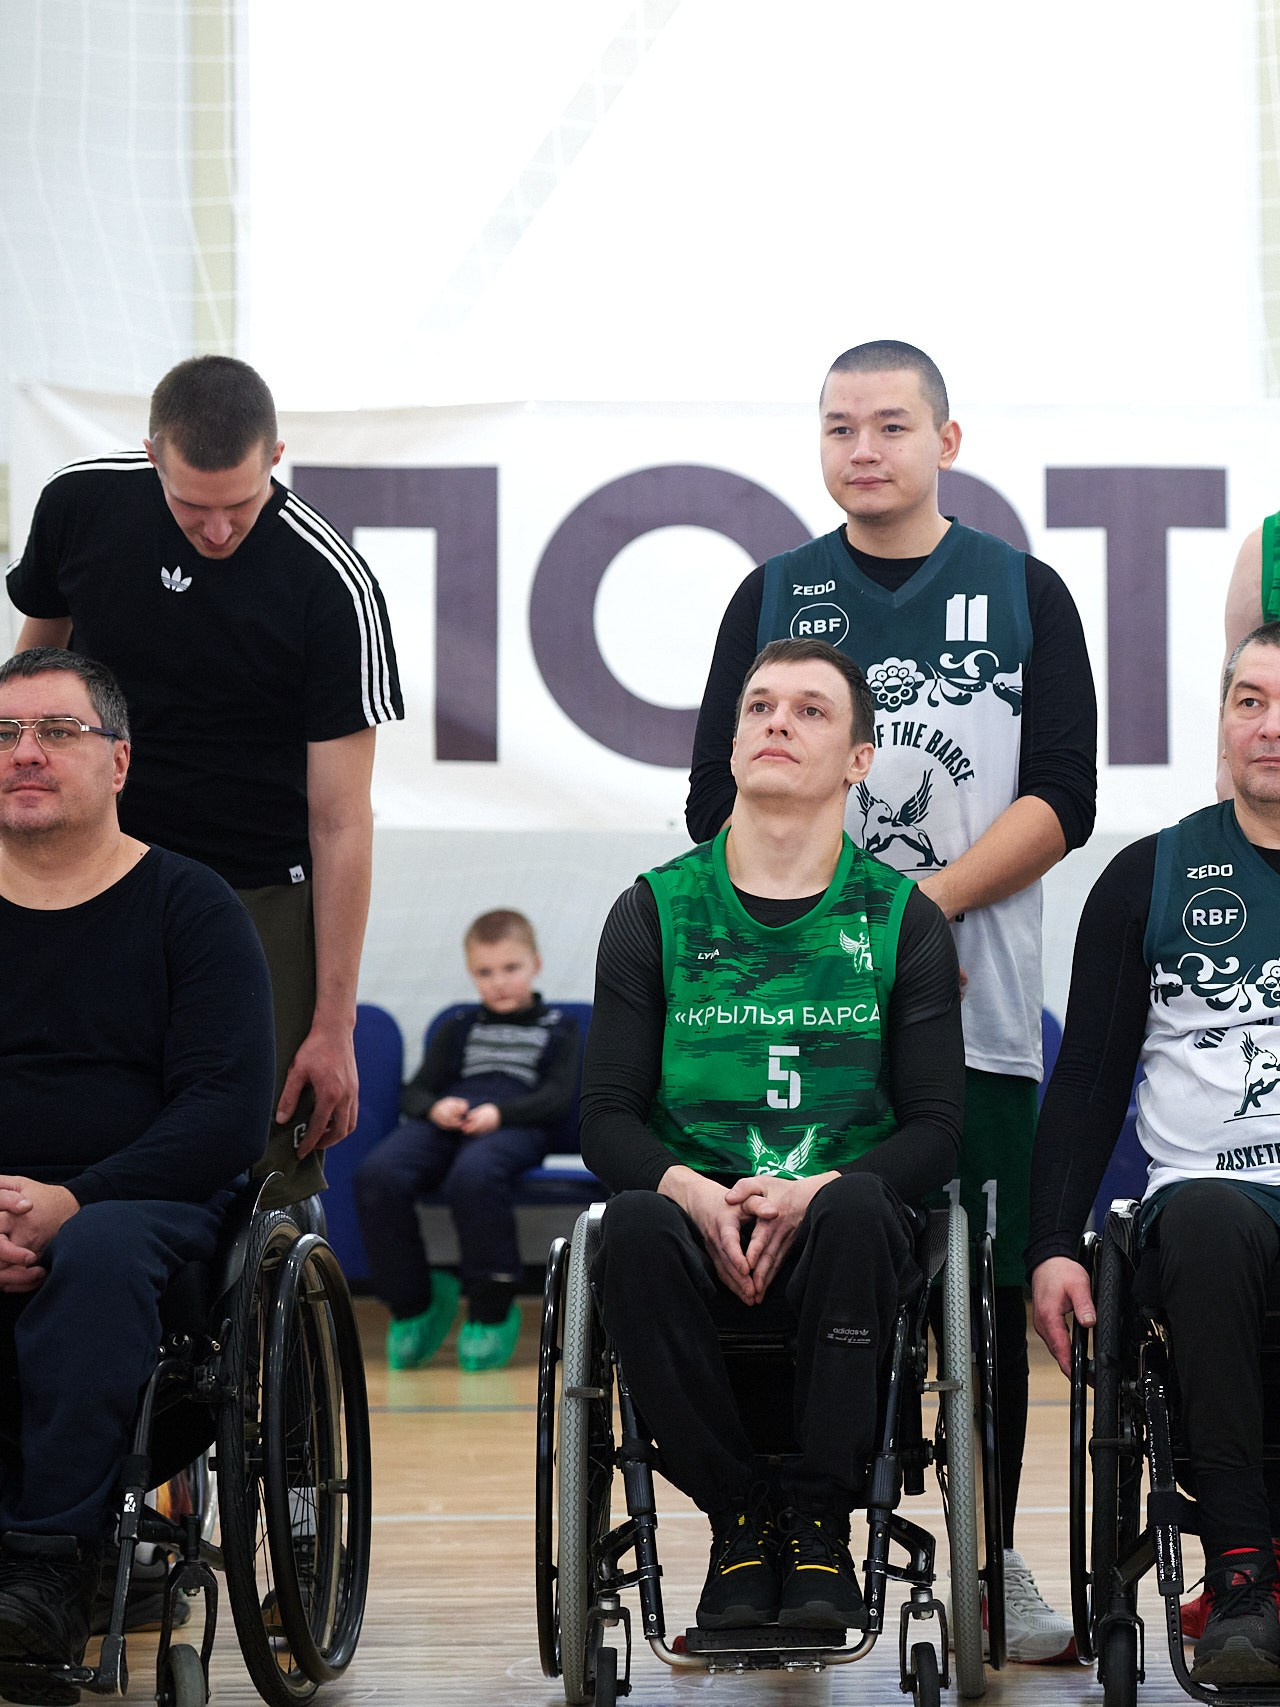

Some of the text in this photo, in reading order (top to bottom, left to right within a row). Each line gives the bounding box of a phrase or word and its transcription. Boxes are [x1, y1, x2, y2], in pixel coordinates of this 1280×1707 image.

[793, 580, 836, 596] ZEDO
[292, 463, 1226, 768] ПОТ
[799, 617, 841, 635] RBF
[945, 593, 988, 642] 11
[873, 721, 975, 787] F THE BARSE
[1186, 863, 1234, 880] ZEDO
[1192, 908, 1239, 927] RBF
[674, 1005, 794, 1027] «КРЫЛЬЯ
[766, 1045, 801, 1110] 5
